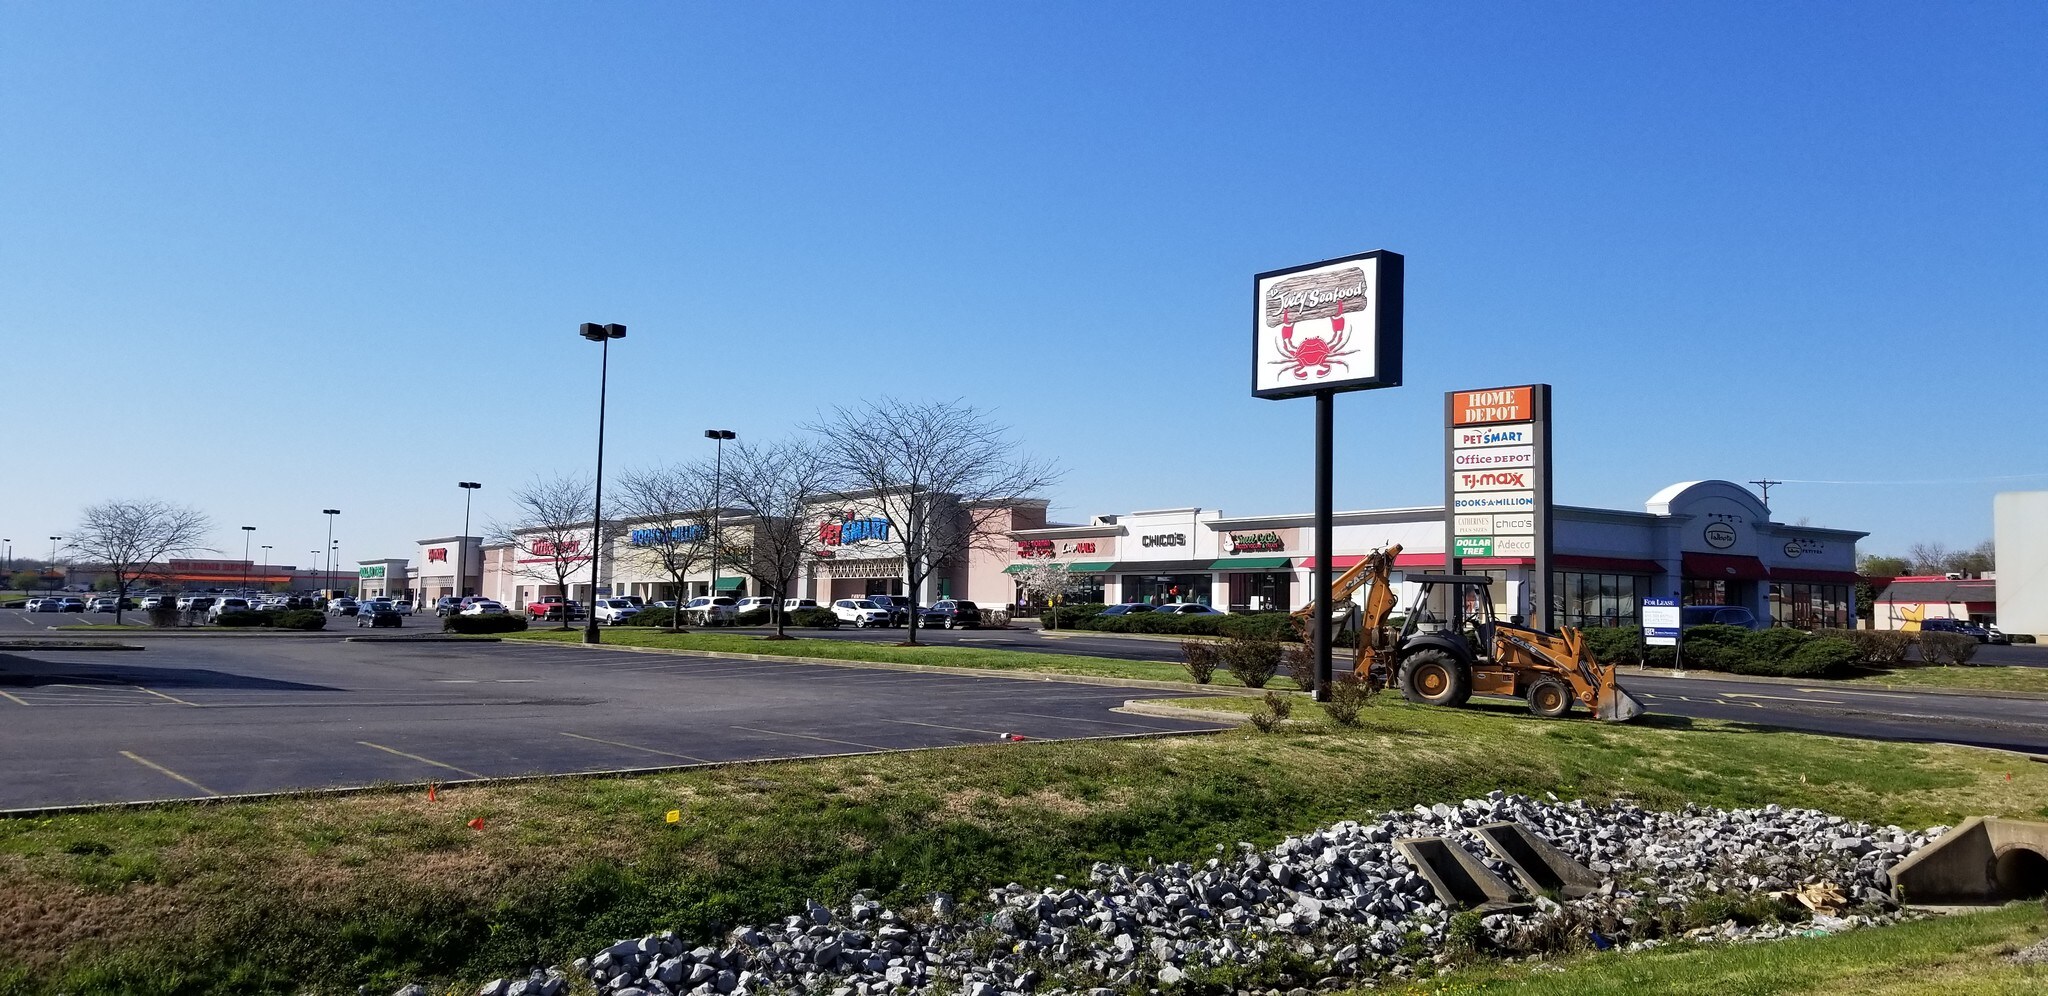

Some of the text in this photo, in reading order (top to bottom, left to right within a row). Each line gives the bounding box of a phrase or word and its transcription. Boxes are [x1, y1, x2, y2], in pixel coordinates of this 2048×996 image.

[1269, 281, 1362, 317] Juicy Seafood
[1469, 390, 1515, 407] HOME
[1465, 406, 1518, 422] DEPOT
[1463, 431, 1522, 444] PETSMART
[1456, 454, 1531, 465] Office DEPOT
[1142, 532, 1186, 547] CHICO'S
[1456, 539, 1491, 547] DOLLAR
[1497, 540, 1532, 549] Adecco
[1462, 547, 1485, 555] TREE
[1511, 636, 1537, 653] CASE
